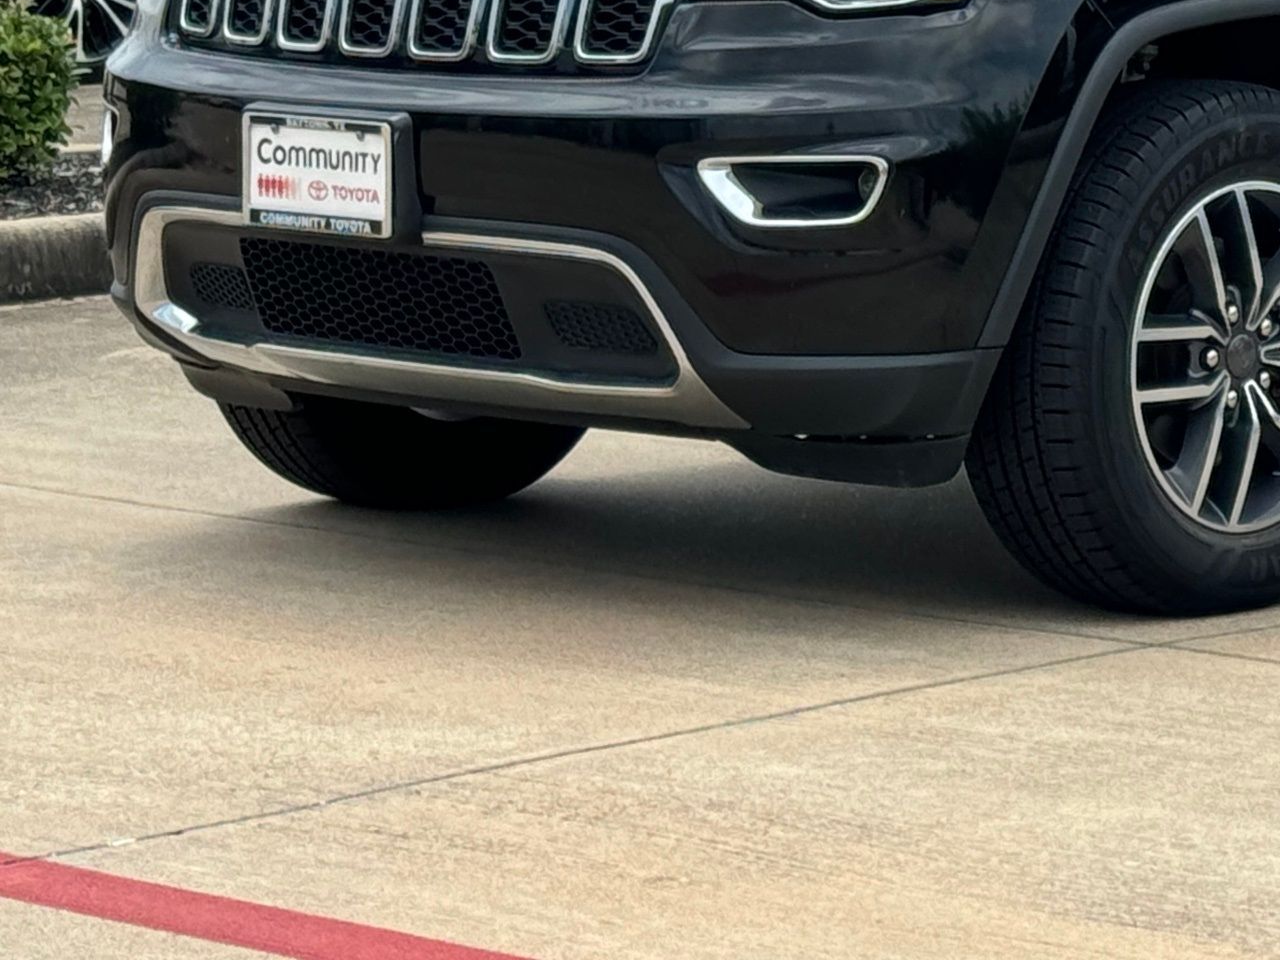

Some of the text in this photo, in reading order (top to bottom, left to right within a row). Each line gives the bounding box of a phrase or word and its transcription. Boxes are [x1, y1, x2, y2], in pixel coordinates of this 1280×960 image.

[332, 185, 380, 204] TOYOTA
[260, 212, 372, 233] COMMUNITY TOYOTA
